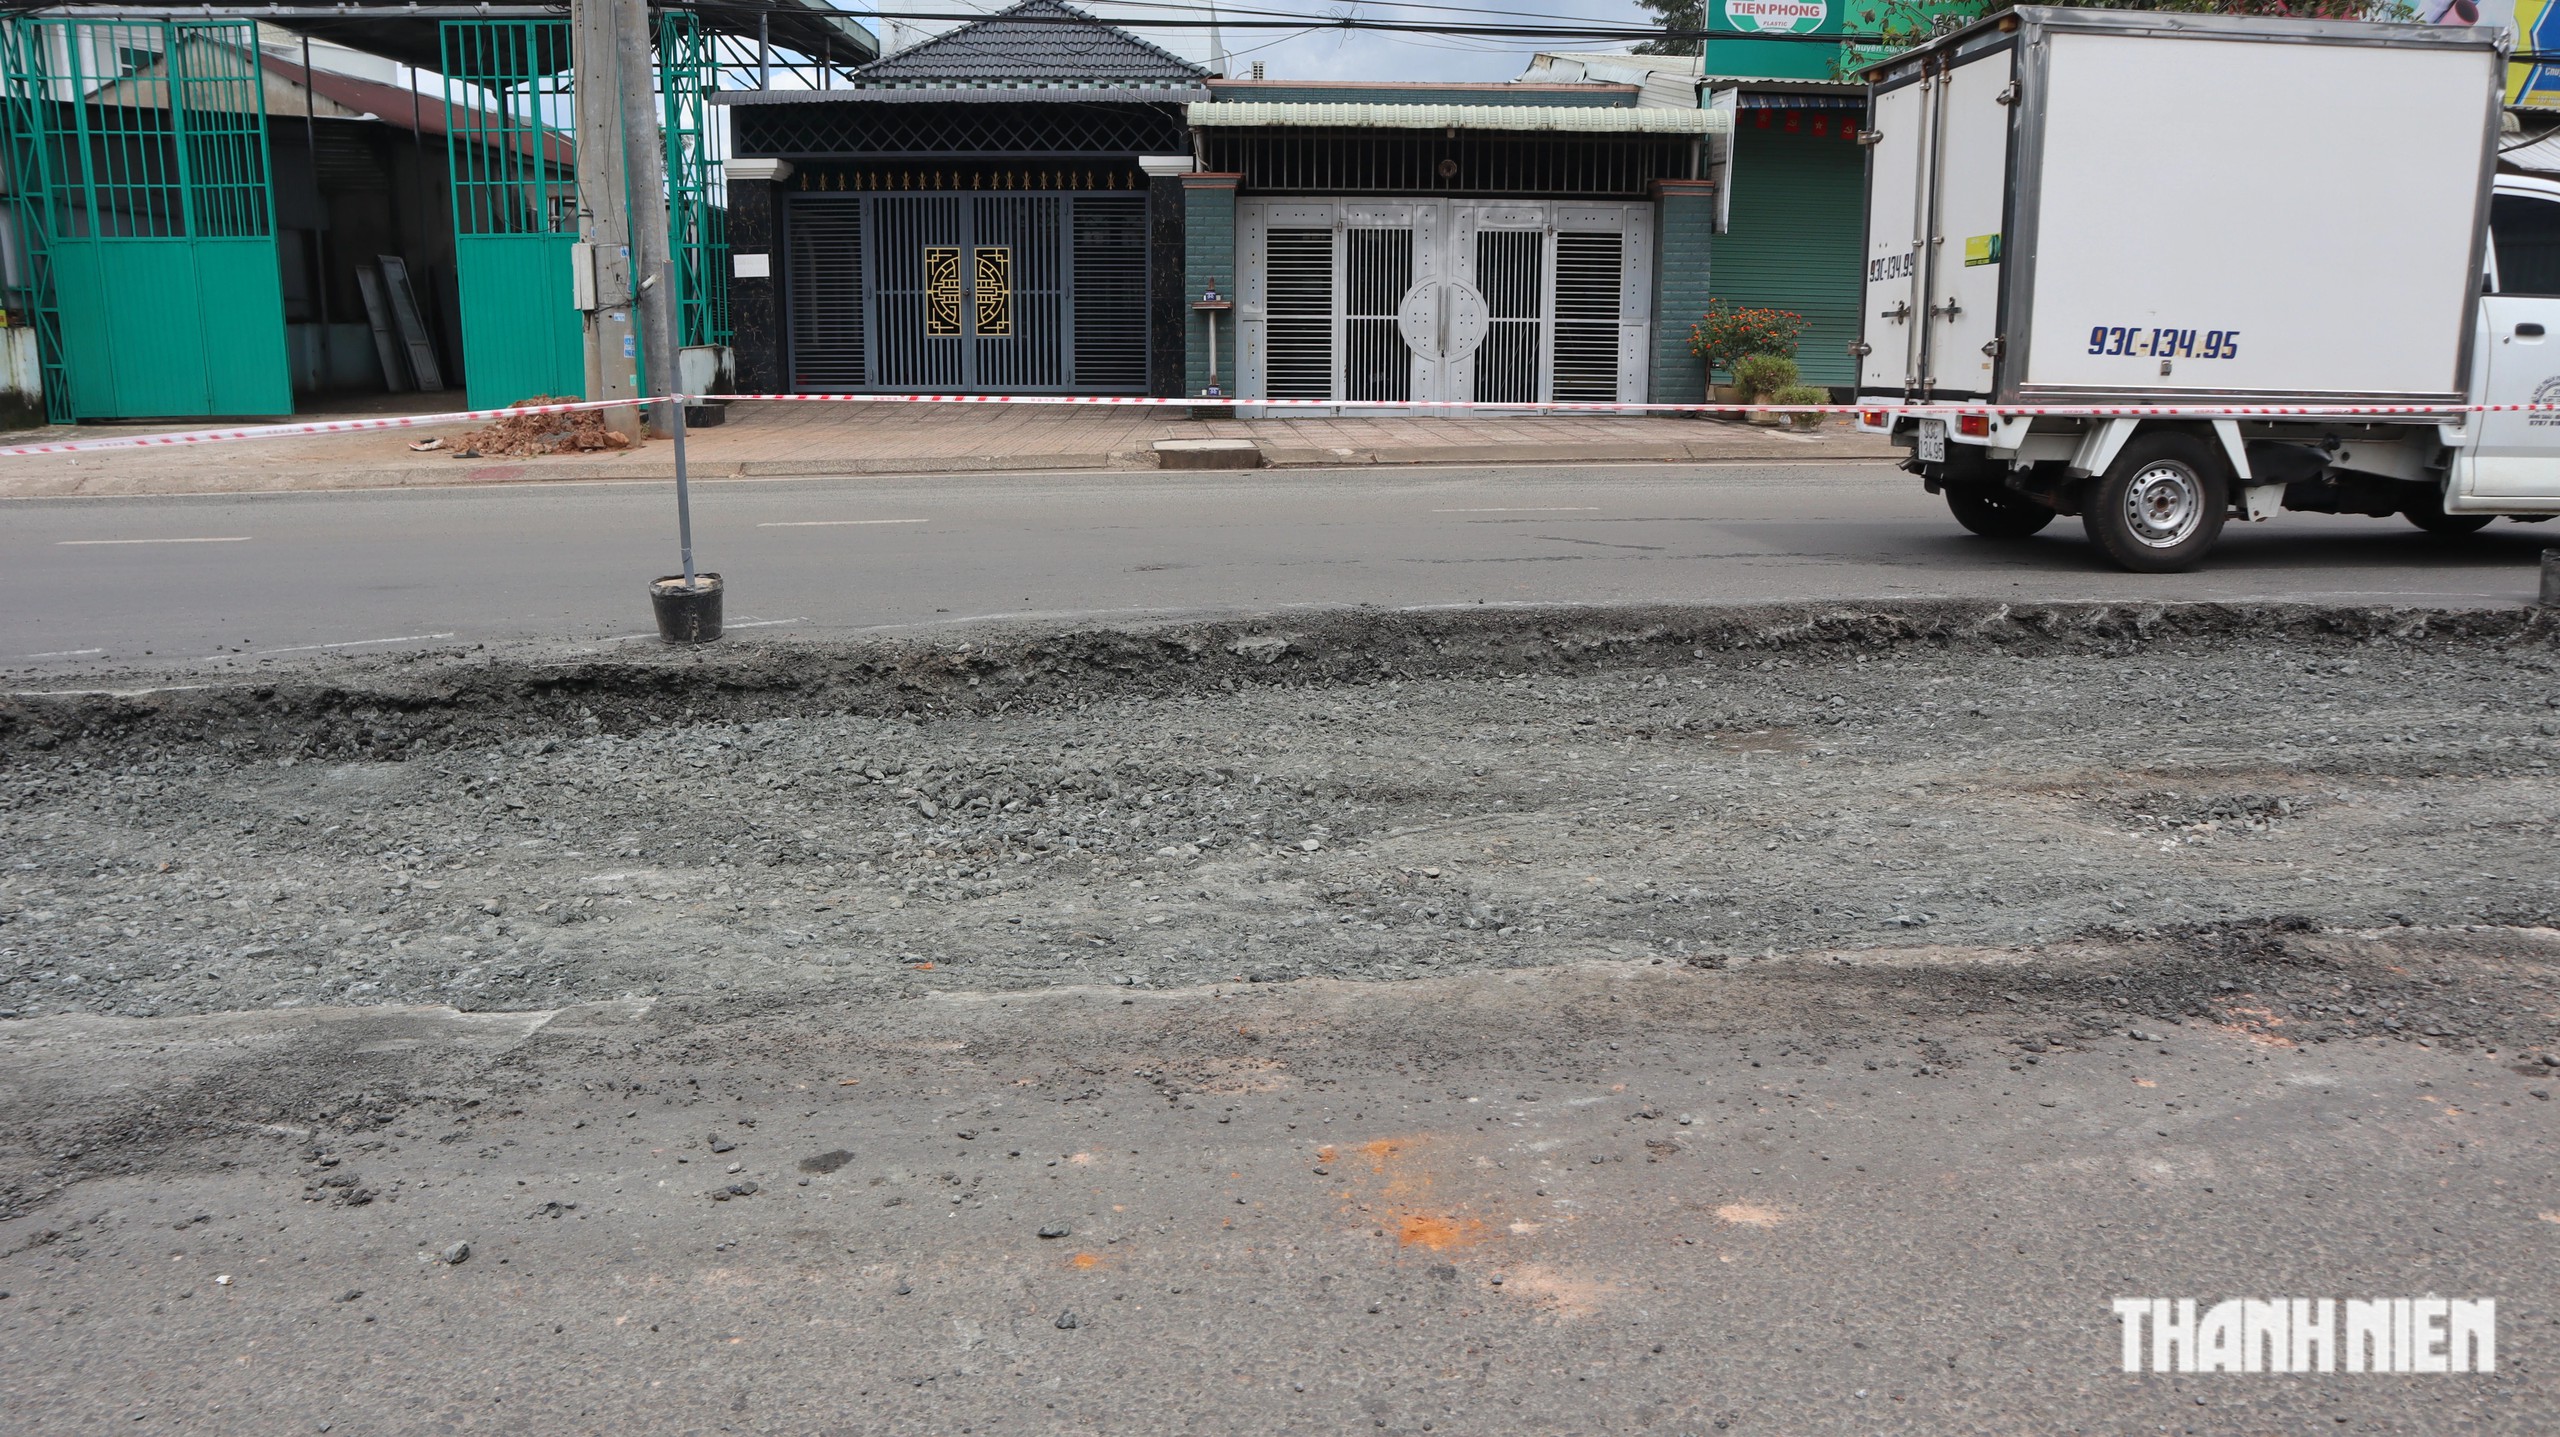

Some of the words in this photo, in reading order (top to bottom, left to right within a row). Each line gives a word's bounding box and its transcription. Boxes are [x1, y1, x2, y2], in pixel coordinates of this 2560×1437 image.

[1733, 3, 1766, 14] TIEN
[1769, 4, 1820, 16] PHONG
[2088, 326, 2240, 359] 93C-134.95
[1924, 421, 1938, 440] 93C
[1920, 440, 1943, 460] 134.95
